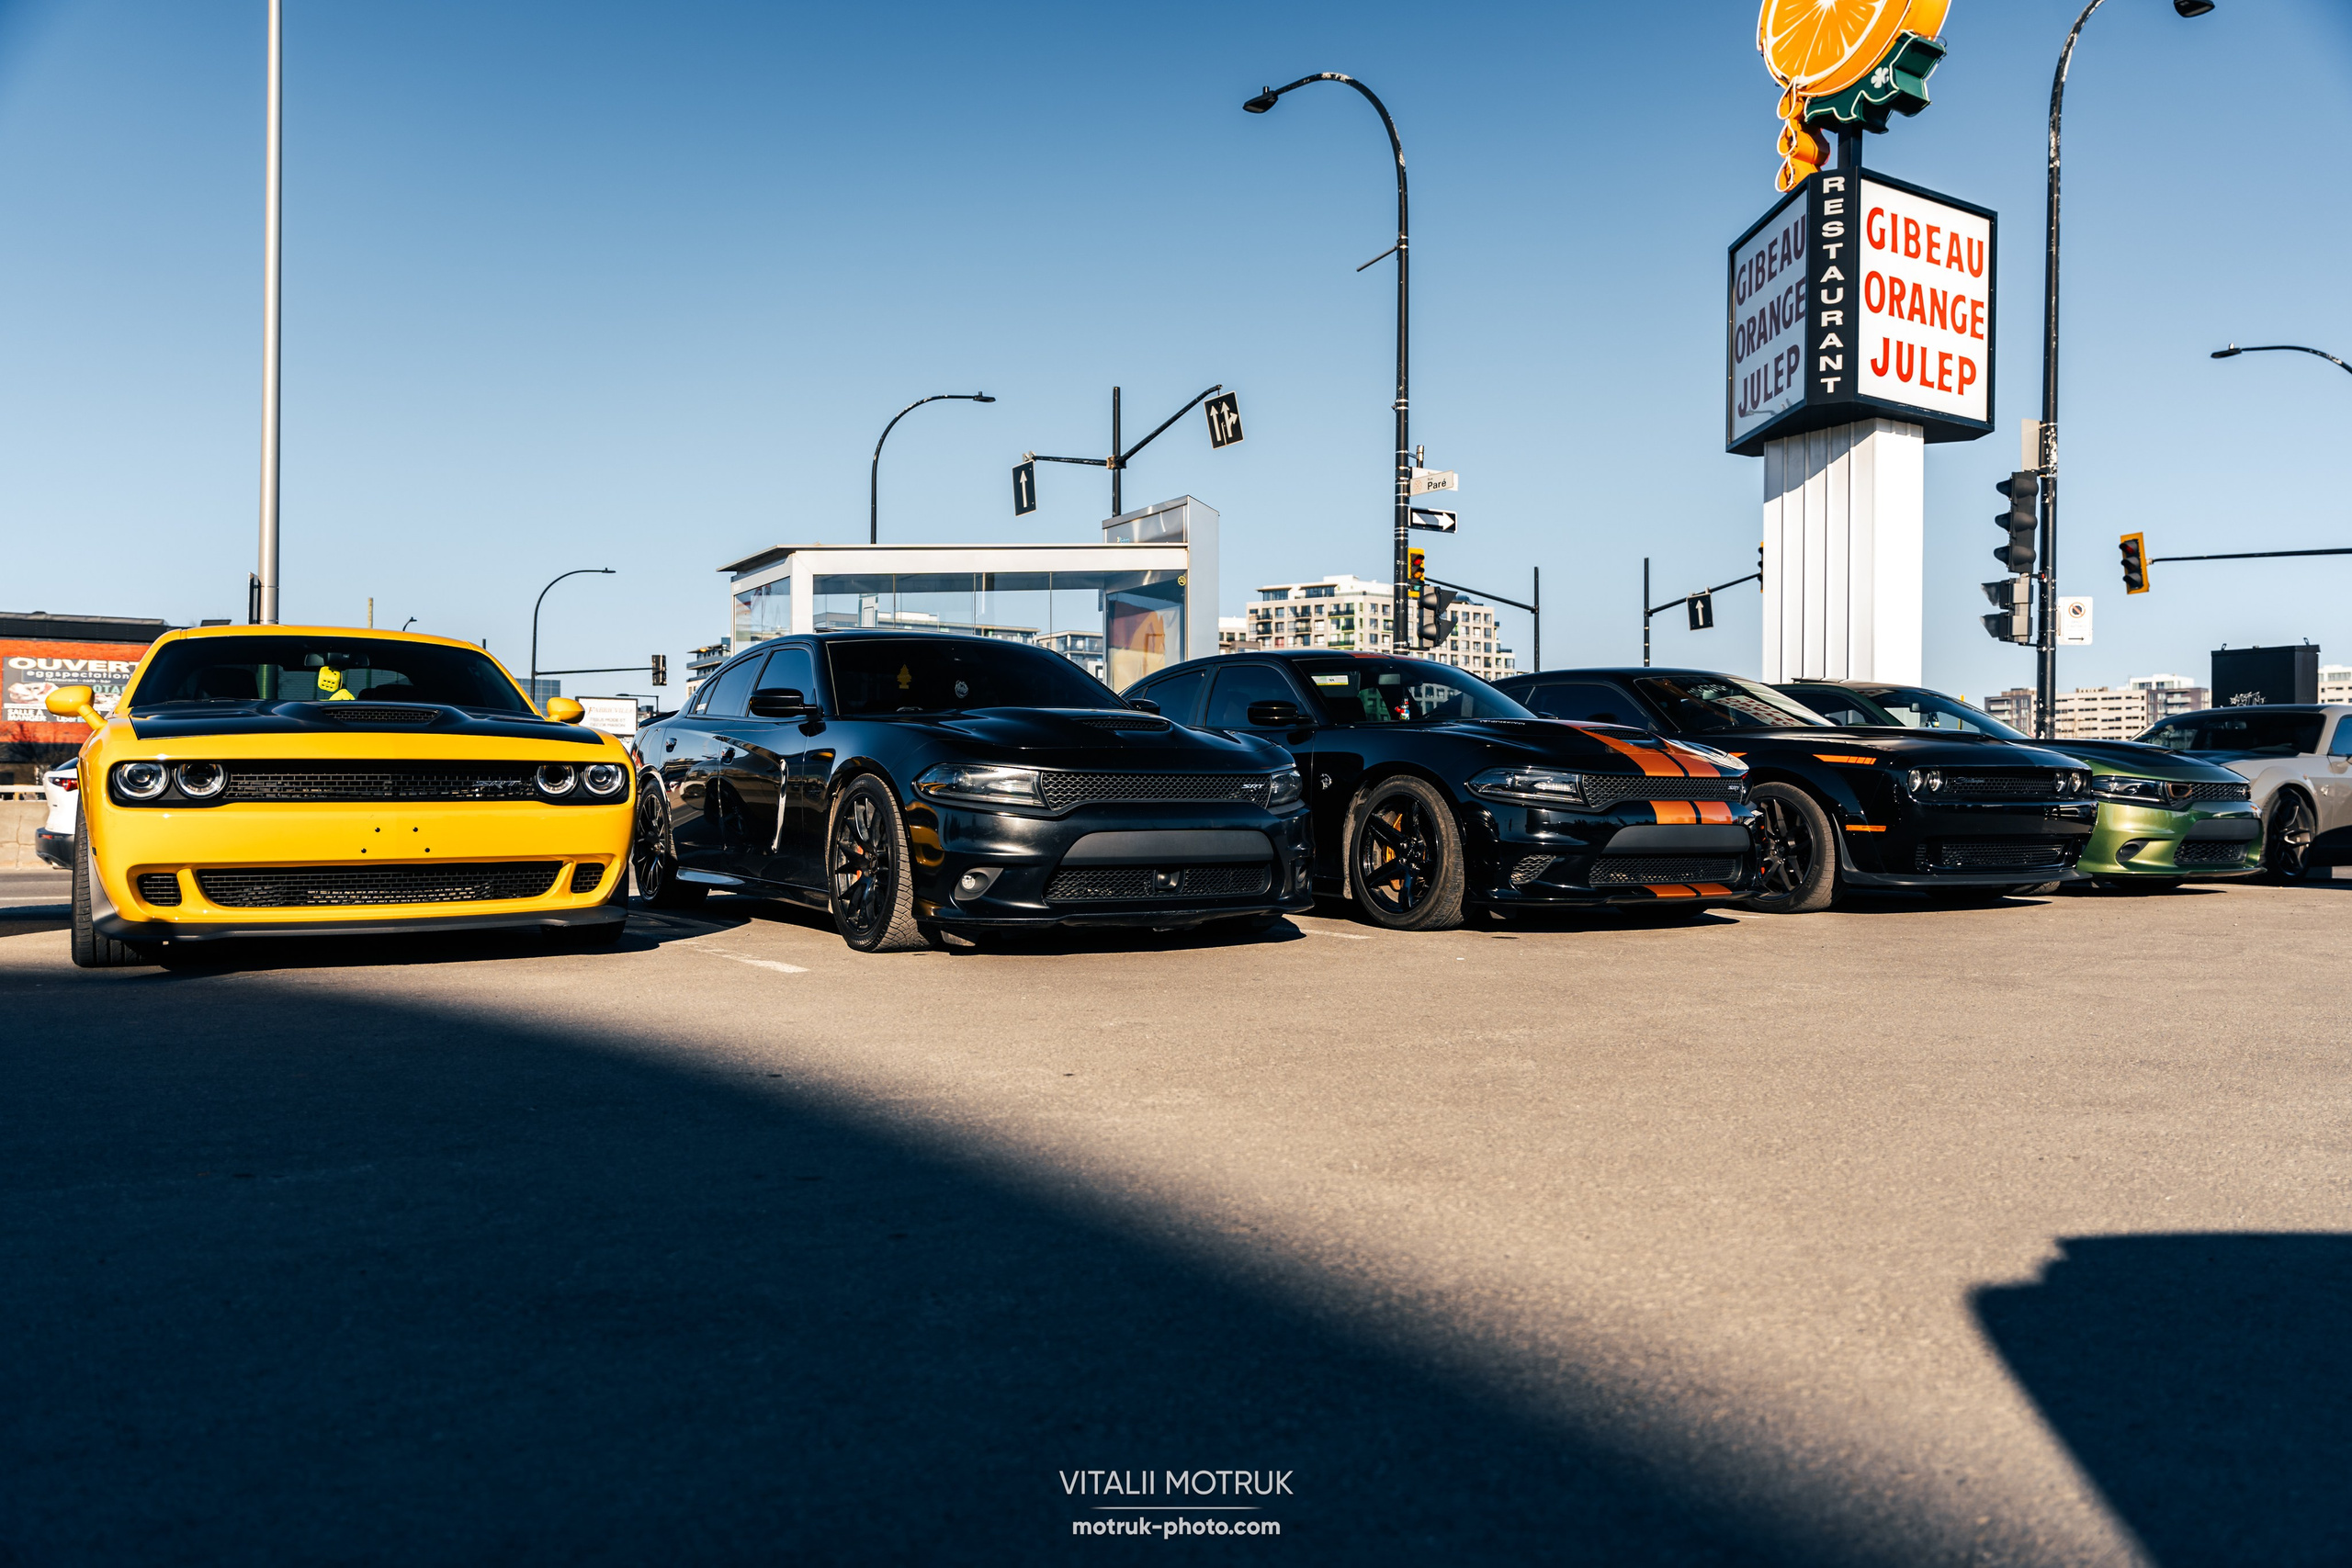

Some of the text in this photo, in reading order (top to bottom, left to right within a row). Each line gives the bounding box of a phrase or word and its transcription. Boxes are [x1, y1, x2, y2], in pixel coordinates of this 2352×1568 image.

[1736, 213, 1806, 307] GIBEAU
[1866, 207, 1984, 278] GIBEAU
[1819, 175, 1846, 394] RESTAURANT
[1864, 270, 1984, 341] ORANGE
[1735, 277, 1806, 364] ORANGE
[1737, 344, 1801, 418] JULEP
[1870, 336, 1977, 396] JULEP
[1427, 478, 1447, 491] Paré
[26, 670, 133, 680] eggspectation
[471, 780, 522, 789] SRT
